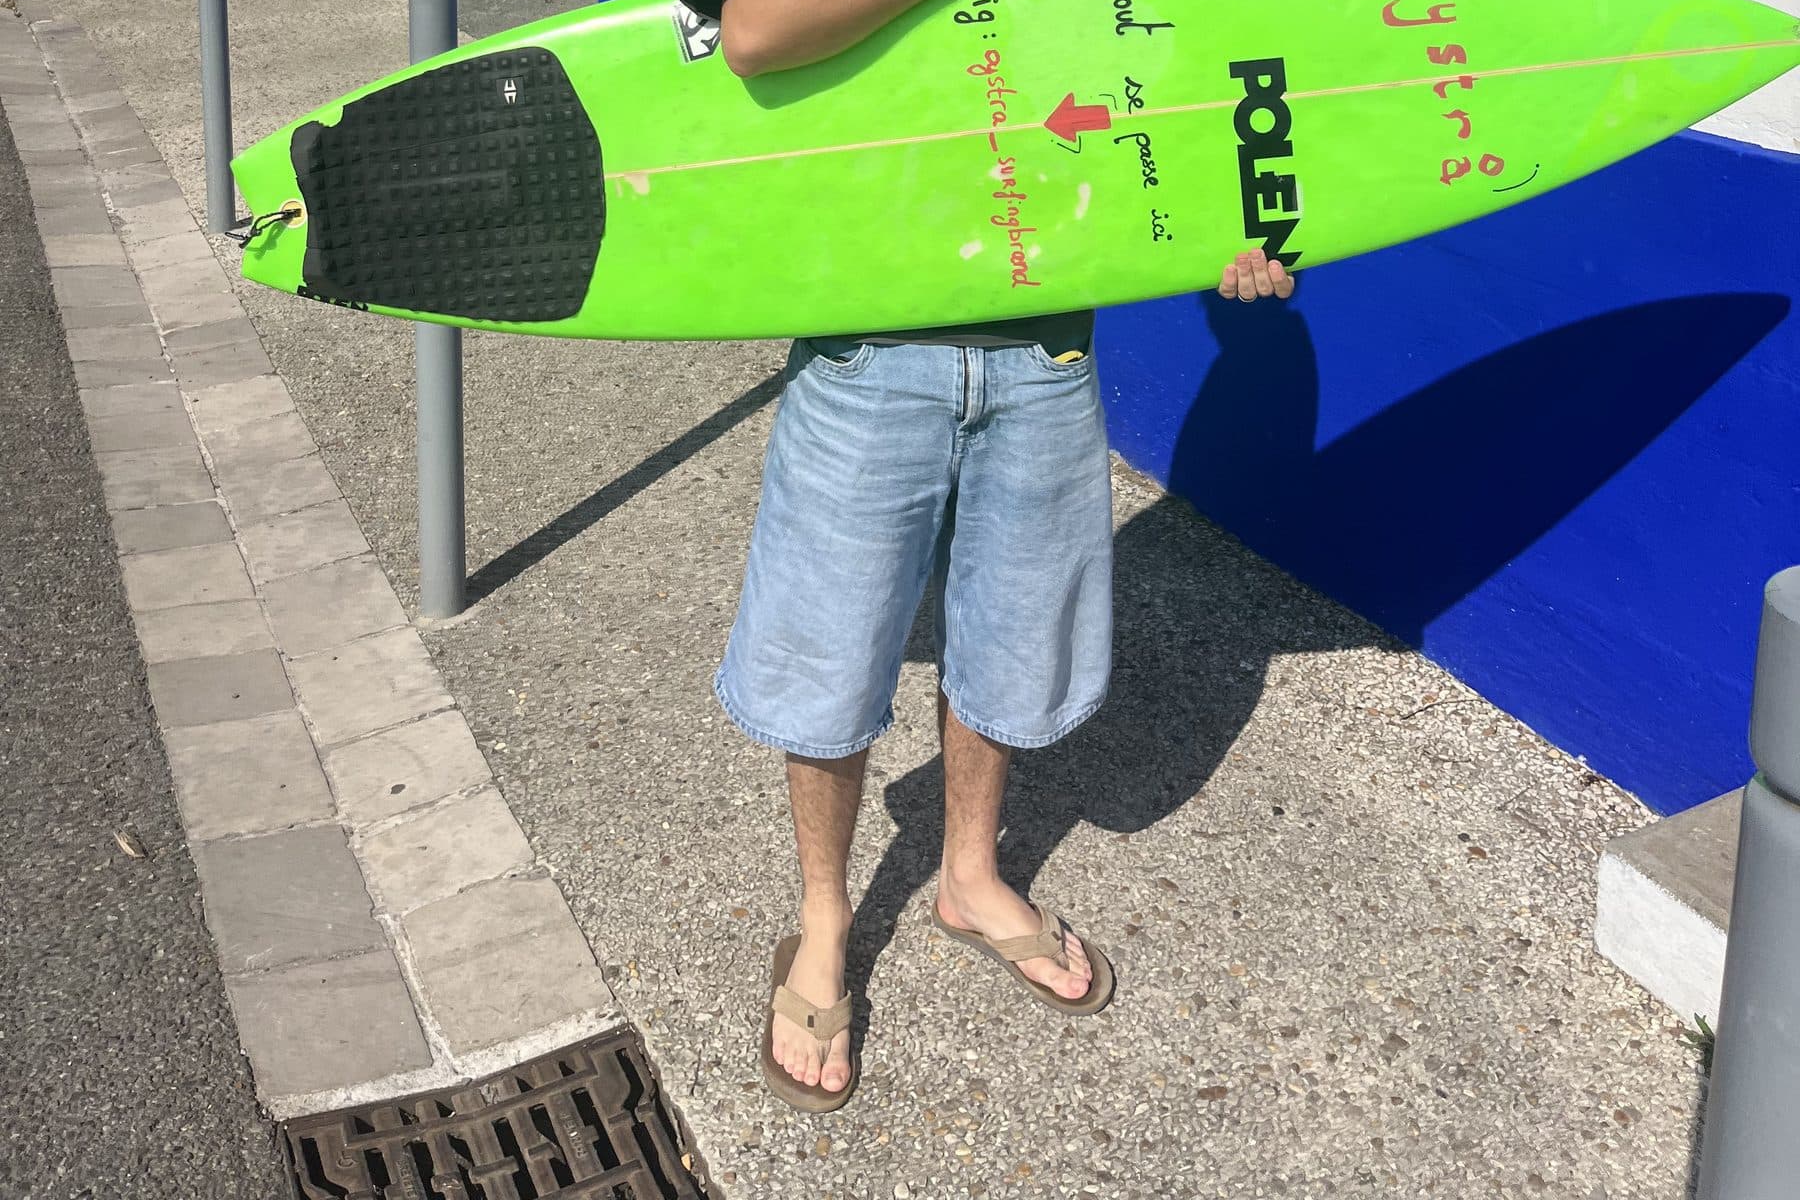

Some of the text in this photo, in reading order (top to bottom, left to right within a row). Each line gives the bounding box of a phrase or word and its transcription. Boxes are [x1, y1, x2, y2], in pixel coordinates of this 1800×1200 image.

[1123, 76, 1145, 115] se
[1113, 132, 1160, 190] passe
[1228, 57, 1303, 268] POLEN
[1151, 209, 1173, 243] ici
